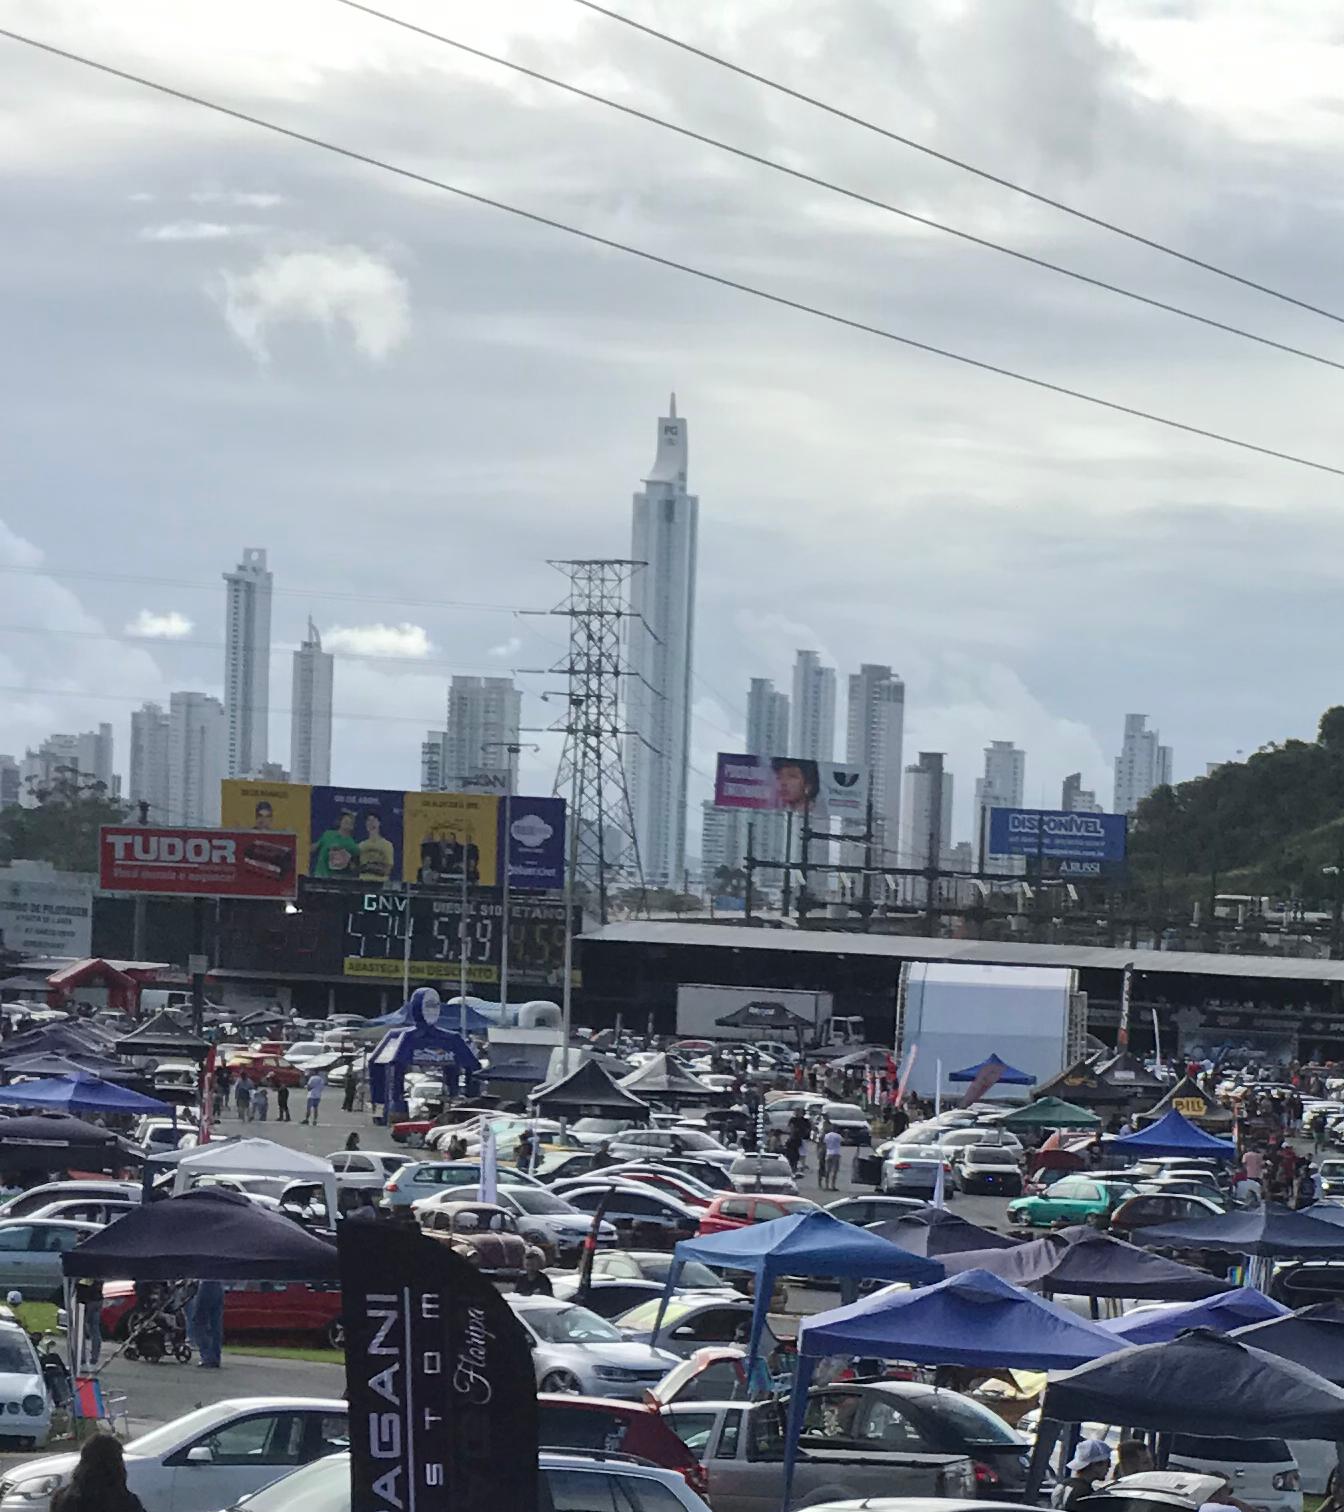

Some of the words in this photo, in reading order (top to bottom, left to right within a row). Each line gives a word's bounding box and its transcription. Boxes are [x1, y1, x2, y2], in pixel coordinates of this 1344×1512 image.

[106, 835, 237, 864] TUDOR
[364, 894, 408, 912] GNV
[511, 906, 575, 921] ETANO
[426, 966, 493, 980] DESCNTO
[1174, 1100, 1204, 1112] BILL
[452, 1306, 497, 1406] Floripa
